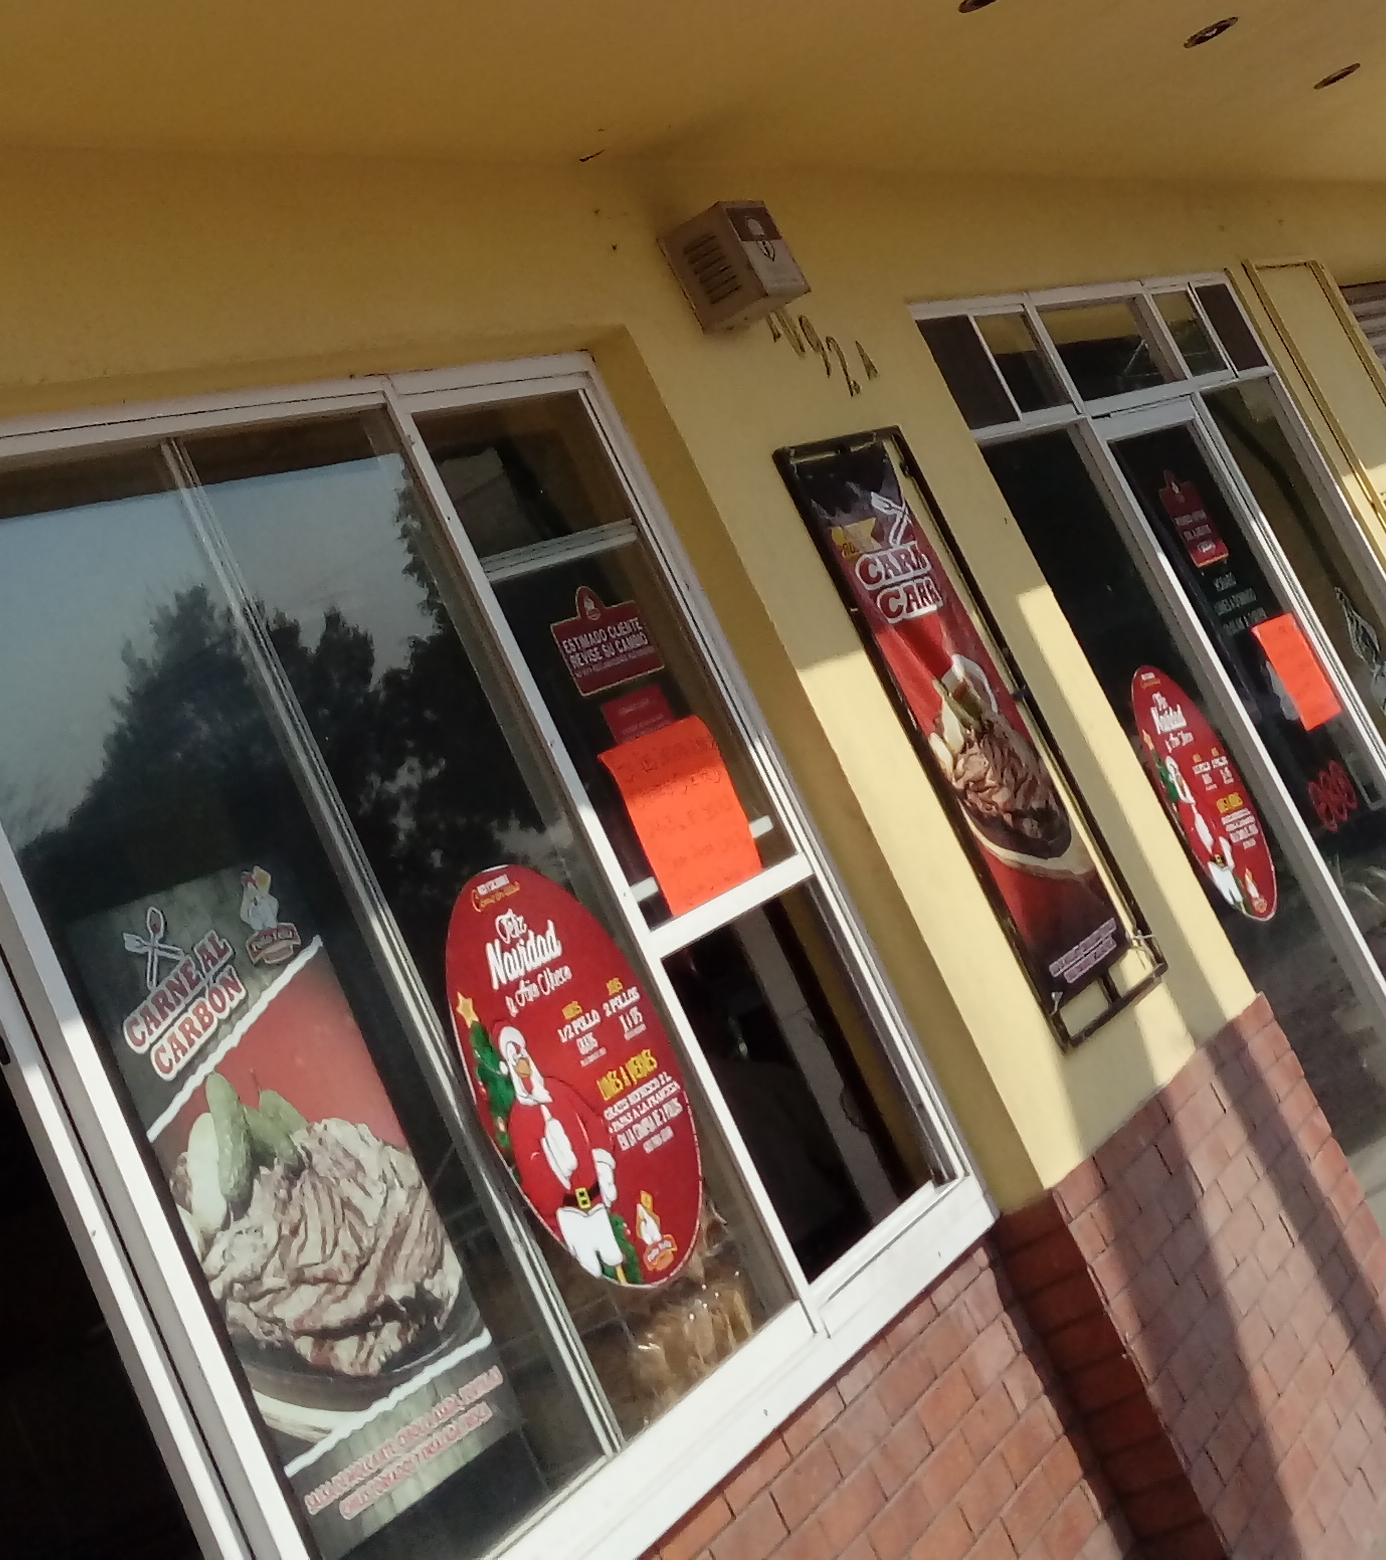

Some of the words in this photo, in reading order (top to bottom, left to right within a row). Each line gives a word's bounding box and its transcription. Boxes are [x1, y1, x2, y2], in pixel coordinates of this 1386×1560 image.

[562, 628, 608, 654] ESTIMADO
[607, 617, 644, 639] CLIENTE
[569, 646, 603, 669] REVISE
[601, 641, 615, 658] SU
[485, 919, 563, 990] Navidad
[125, 957, 204, 1049] CARNE
[196, 932, 232, 975] AL
